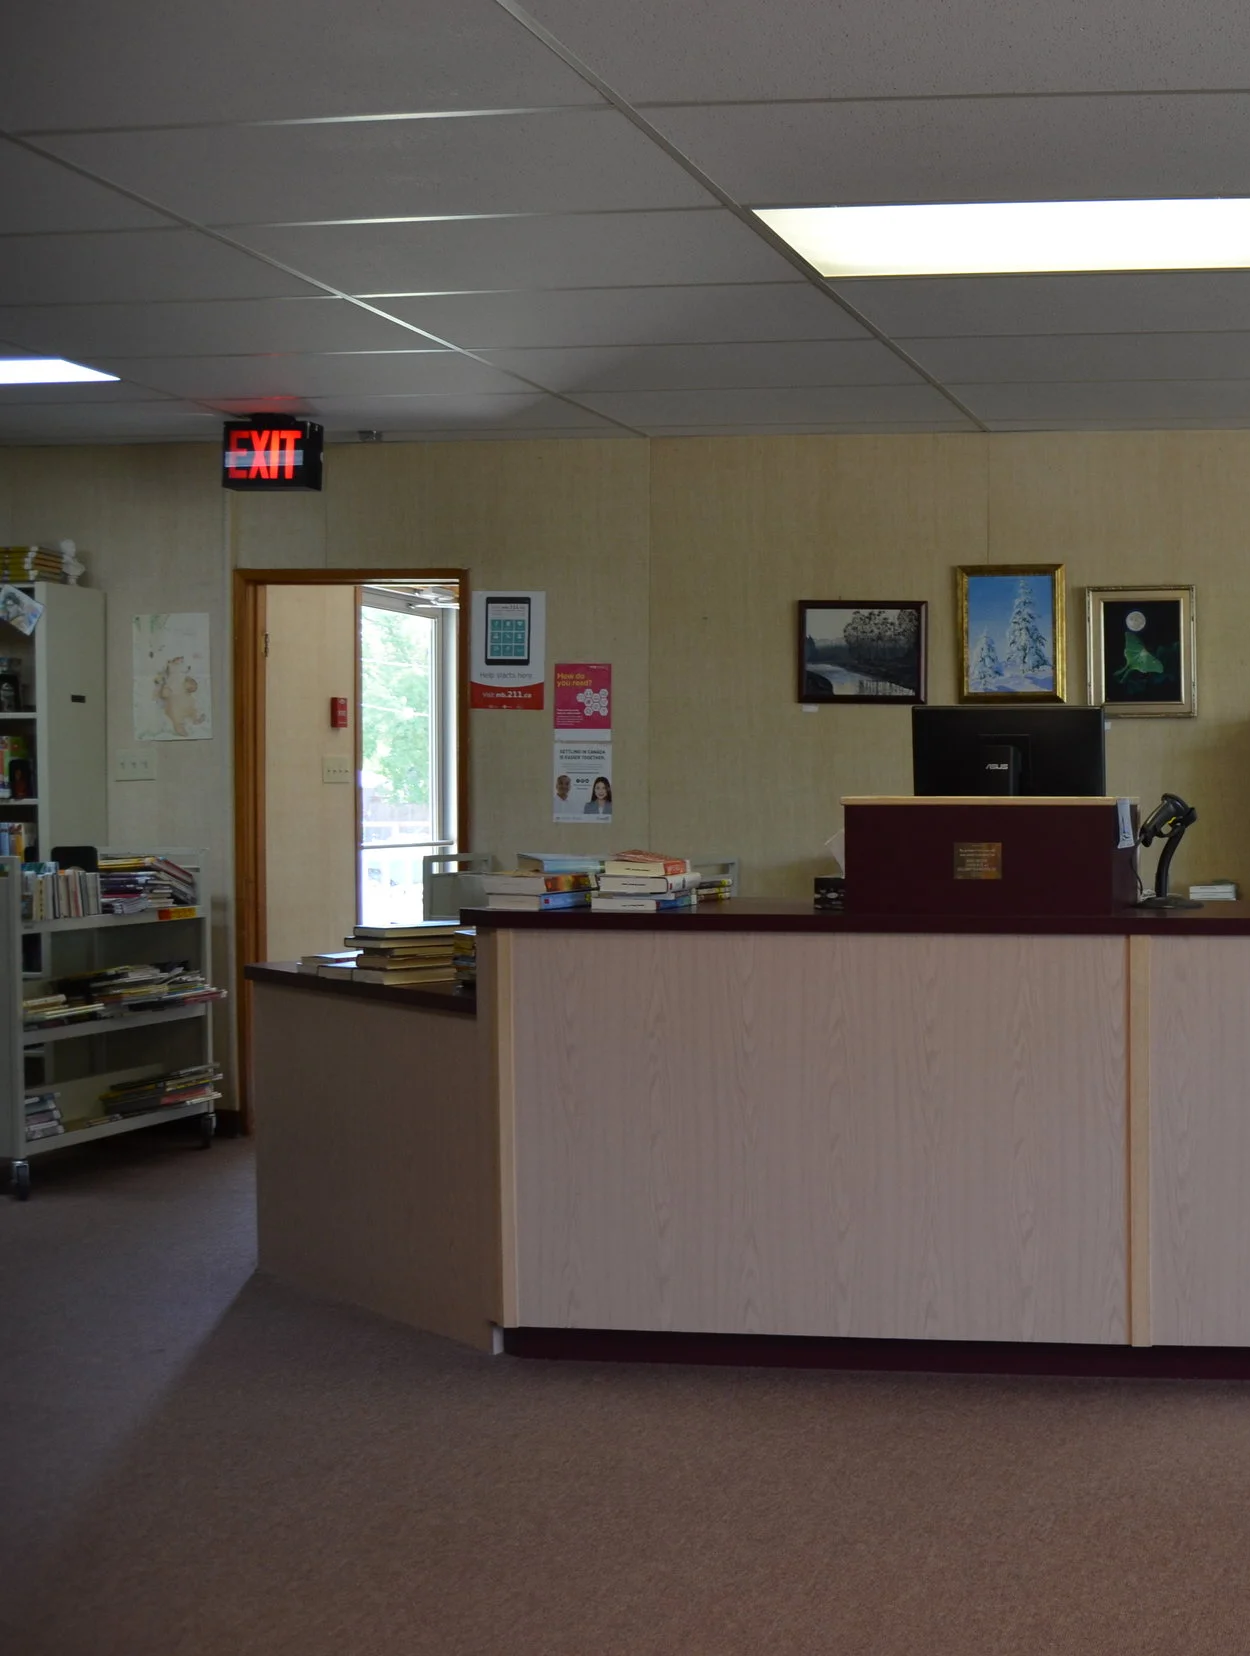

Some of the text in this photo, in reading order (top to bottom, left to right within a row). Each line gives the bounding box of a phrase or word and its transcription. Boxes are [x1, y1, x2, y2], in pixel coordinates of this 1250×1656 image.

[229, 430, 303, 480] EXIT
[557, 672, 574, 680] How
[556, 679, 593, 688] you read?
[496, 690, 532, 699] mb.211.ca
